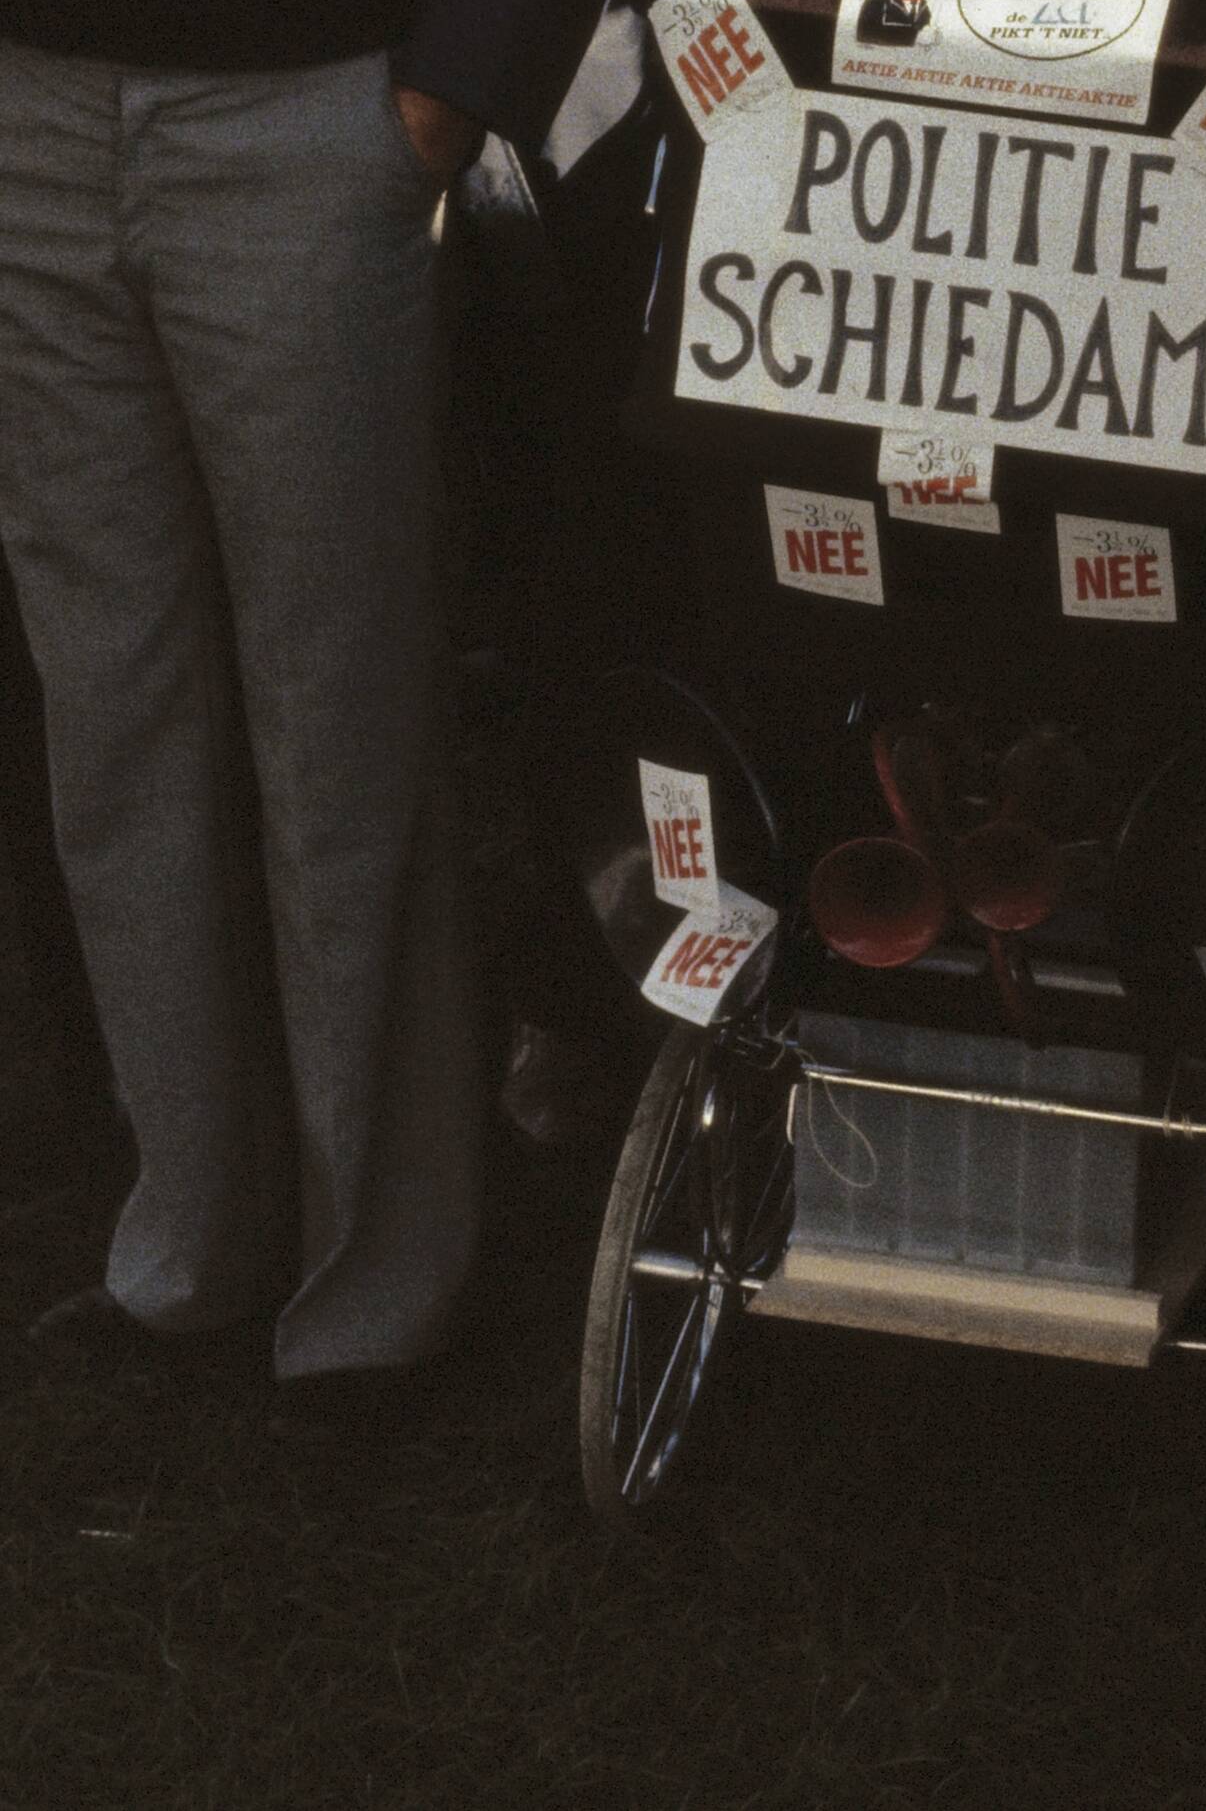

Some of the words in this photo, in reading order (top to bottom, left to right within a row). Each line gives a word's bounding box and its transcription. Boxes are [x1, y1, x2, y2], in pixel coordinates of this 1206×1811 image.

[990, 26, 1034, 40] PIKT
[1006, 12, 1027, 23] de
[676, 4, 766, 117] NEE
[842, 59, 898, 77] AKTIE
[901, 68, 957, 86] AKTIE
[960, 76, 1015, 93] AKTIE
[1019, 83, 1076, 100] AKTIE
[1078, 89, 1138, 108] AKTIE
[784, 110, 1176, 285] POLITIE
[784, 529, 869, 578] NEE
[1074, 554, 1162, 601] NEE
[653, 818, 708, 880] NEE
[661, 931, 754, 990] NEE
